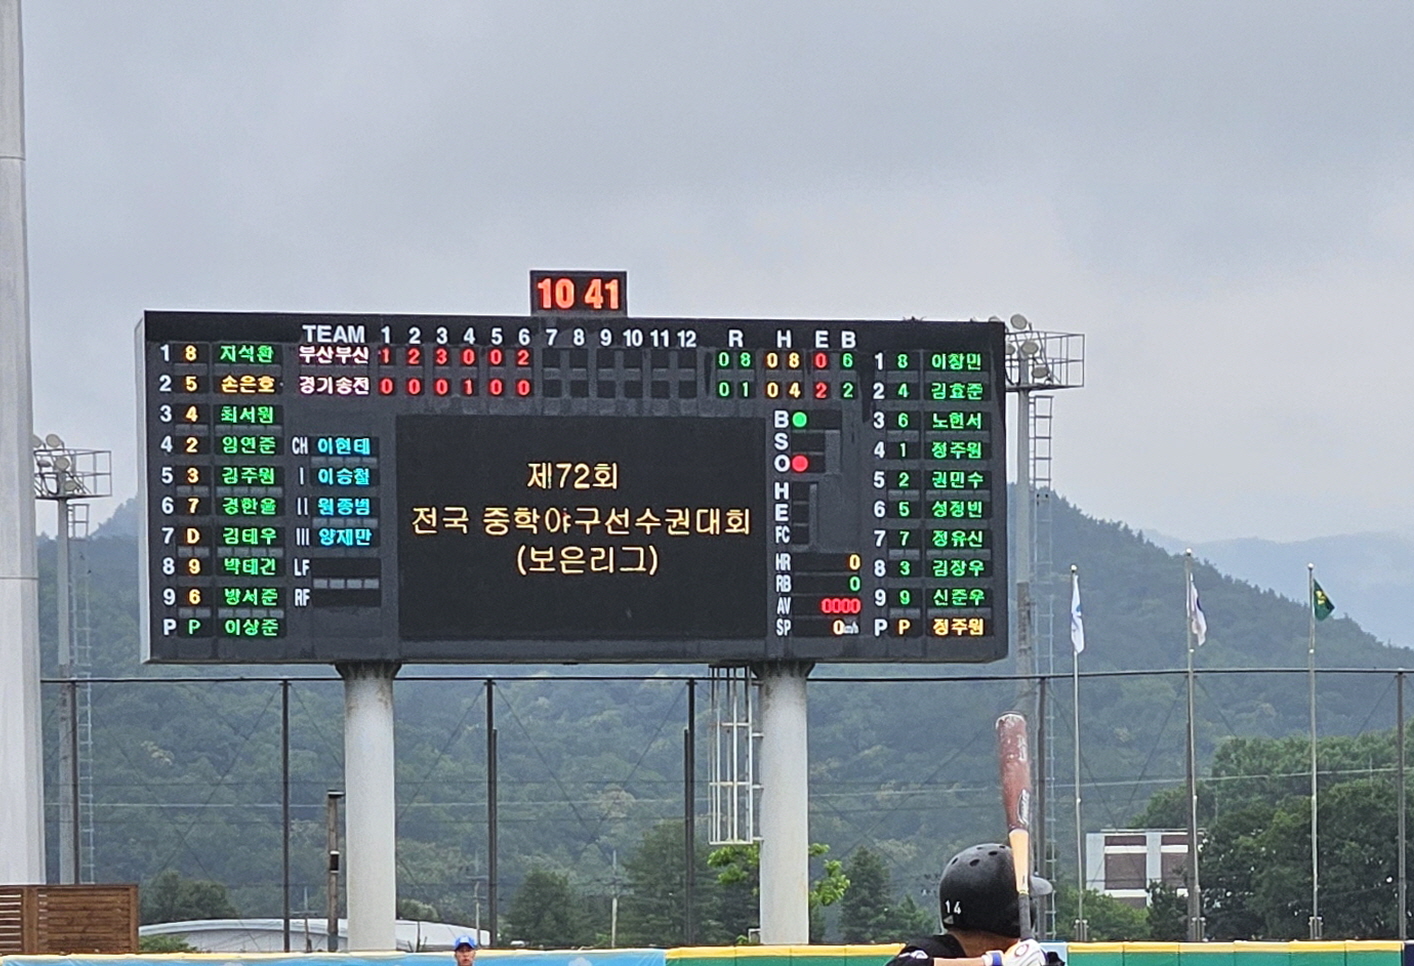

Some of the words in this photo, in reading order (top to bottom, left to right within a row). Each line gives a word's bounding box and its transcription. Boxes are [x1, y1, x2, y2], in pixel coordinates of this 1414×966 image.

[538, 279, 574, 308] 10
[585, 279, 618, 308] 41
[303, 325, 364, 343] TEAM
[382, 326, 389, 343] 1
[409, 327, 420, 344] 2
[437, 327, 447, 344] 3
[464, 328, 475, 344] 4
[492, 328, 502, 344] 5
[519, 329, 530, 345] 6
[546, 329, 557, 345] 7
[574, 329, 584, 345] 8
[601, 329, 611, 346] 9
[623, 330, 642, 346] 10
[651, 330, 668, 347] 11
[678, 331, 696, 347] 12
[729, 330, 742, 347] R
[778, 330, 791, 348] H
[816, 331, 828, 348] E
[842, 331, 855, 348] B
[161, 345, 169, 361] 1
[186, 345, 196, 361] 8
[383, 349, 389, 363] 1
[409, 349, 419, 364] 2
[437, 349, 446, 364] 3
[463, 349, 474, 364] 0
[491, 350, 501, 364] 0
[518, 350, 528, 364] 2
[816, 353, 826, 368] 0
[843, 353, 852, 367] 6
[875, 353, 882, 370] 1
[898, 354, 907, 368] 8
[160, 375, 171, 391] 2
[186, 376, 197, 391] 5
[222, 375, 274, 393] 손은호
[300, 377, 368, 394] 경기송전
[381, 379, 392, 393] 0
[409, 379, 420, 394] 0
[436, 379, 447, 394] 0
[465, 380, 472, 394] 1
[491, 380, 502, 394] 0
[518, 380, 529, 395] 0
[816, 383, 826, 398] 2
[843, 383, 853, 397] 2
[874, 383, 884, 399] 2
[898, 384, 908, 397] 4
[161, 405, 171, 422] 3
[186, 406, 197, 422] 4
[221, 406, 273, 423] 최서원
[775, 411, 788, 428] B
[874, 412, 884, 428] 3
[899, 413, 908, 427] 6
[161, 436, 172, 452] 4
[187, 437, 198, 452] 2
[292, 437, 308, 454] CH
[775, 433, 788, 450] S
[874, 442, 885, 458] 4
[901, 443, 905, 457] 1
[774, 455, 790, 471] O
[162, 467, 173, 483] 5
[188, 468, 198, 483] 3
[528, 463, 617, 489] 제72회
[874, 471, 884, 488] 5
[899, 473, 909, 487] 2
[775, 482, 789, 499] H
[162, 497, 173, 514] 6
[189, 498, 198, 513] 7
[775, 504, 788, 521] E
[874, 501, 885, 517] 6
[899, 502, 909, 516] 5
[413, 507, 468, 533] 전국
[484, 508, 749, 535] 중학야구선수권대회
[162, 528, 174, 544] 7
[187, 528, 199, 543] D
[776, 526, 790, 543] FC
[874, 530, 885, 546] 7
[900, 531, 909, 545] 7
[163, 558, 174, 574] 8
[189, 559, 200, 574] 9
[295, 559, 309, 576] LF
[518, 545, 657, 575] (보은리그)
[776, 553, 790, 570] HR
[850, 555, 860, 570] 0
[875, 560, 885, 576] 8
[900, 561, 909, 575] 3
[776, 575, 791, 592] RB
[850, 577, 860, 591] 0
[164, 589, 175, 605] 9
[189, 589, 200, 604] 6
[777, 597, 791, 614] AV
[821, 598, 861, 613] 0000
[875, 589, 885, 606] 9
[900, 590, 910, 604] 9
[164, 619, 176, 635] P
[189, 620, 200, 634] P
[777, 619, 791, 635] SP
[875, 619, 887, 636] P
[899, 620, 910, 634] P
[933, 618, 983, 635] 정주원
[944, 900, 962, 915] 14
